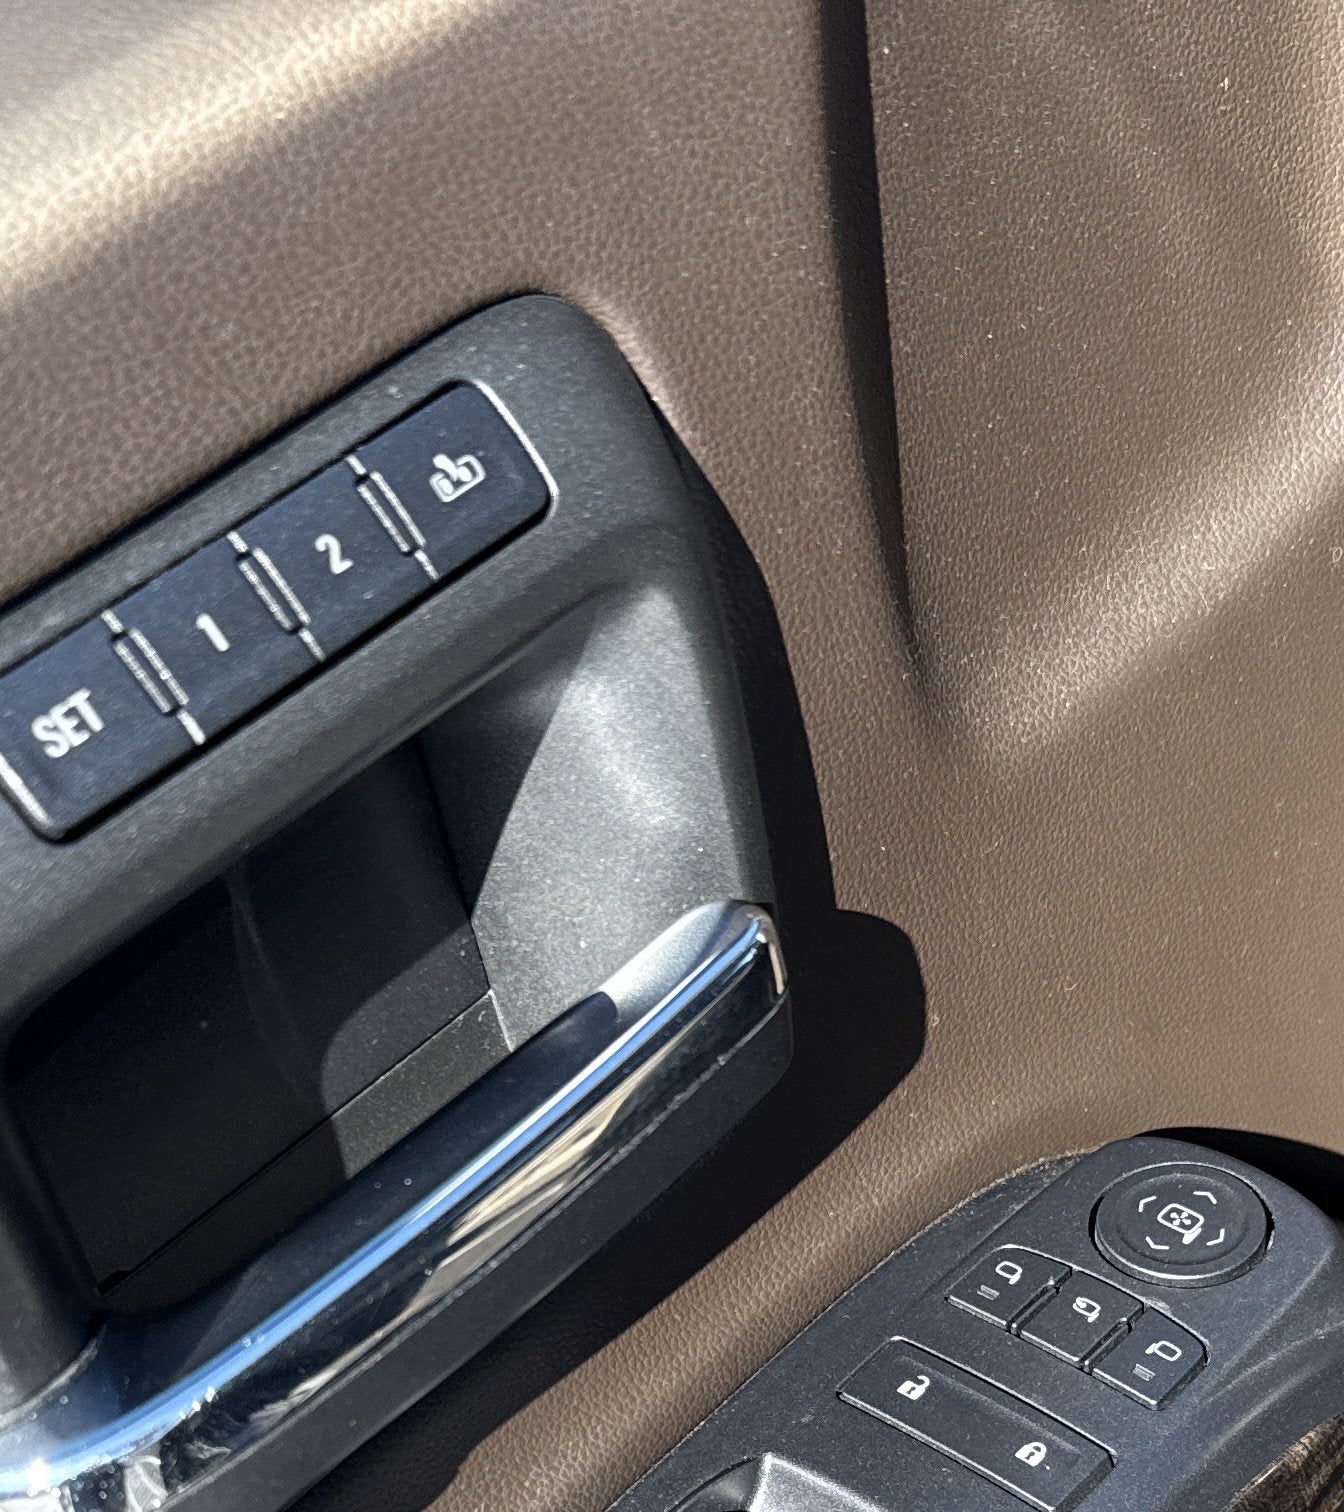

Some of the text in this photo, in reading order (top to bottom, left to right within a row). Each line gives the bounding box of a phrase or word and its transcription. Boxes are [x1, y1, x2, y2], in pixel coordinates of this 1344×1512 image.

[30, 532, 353, 759] SET 1 2
